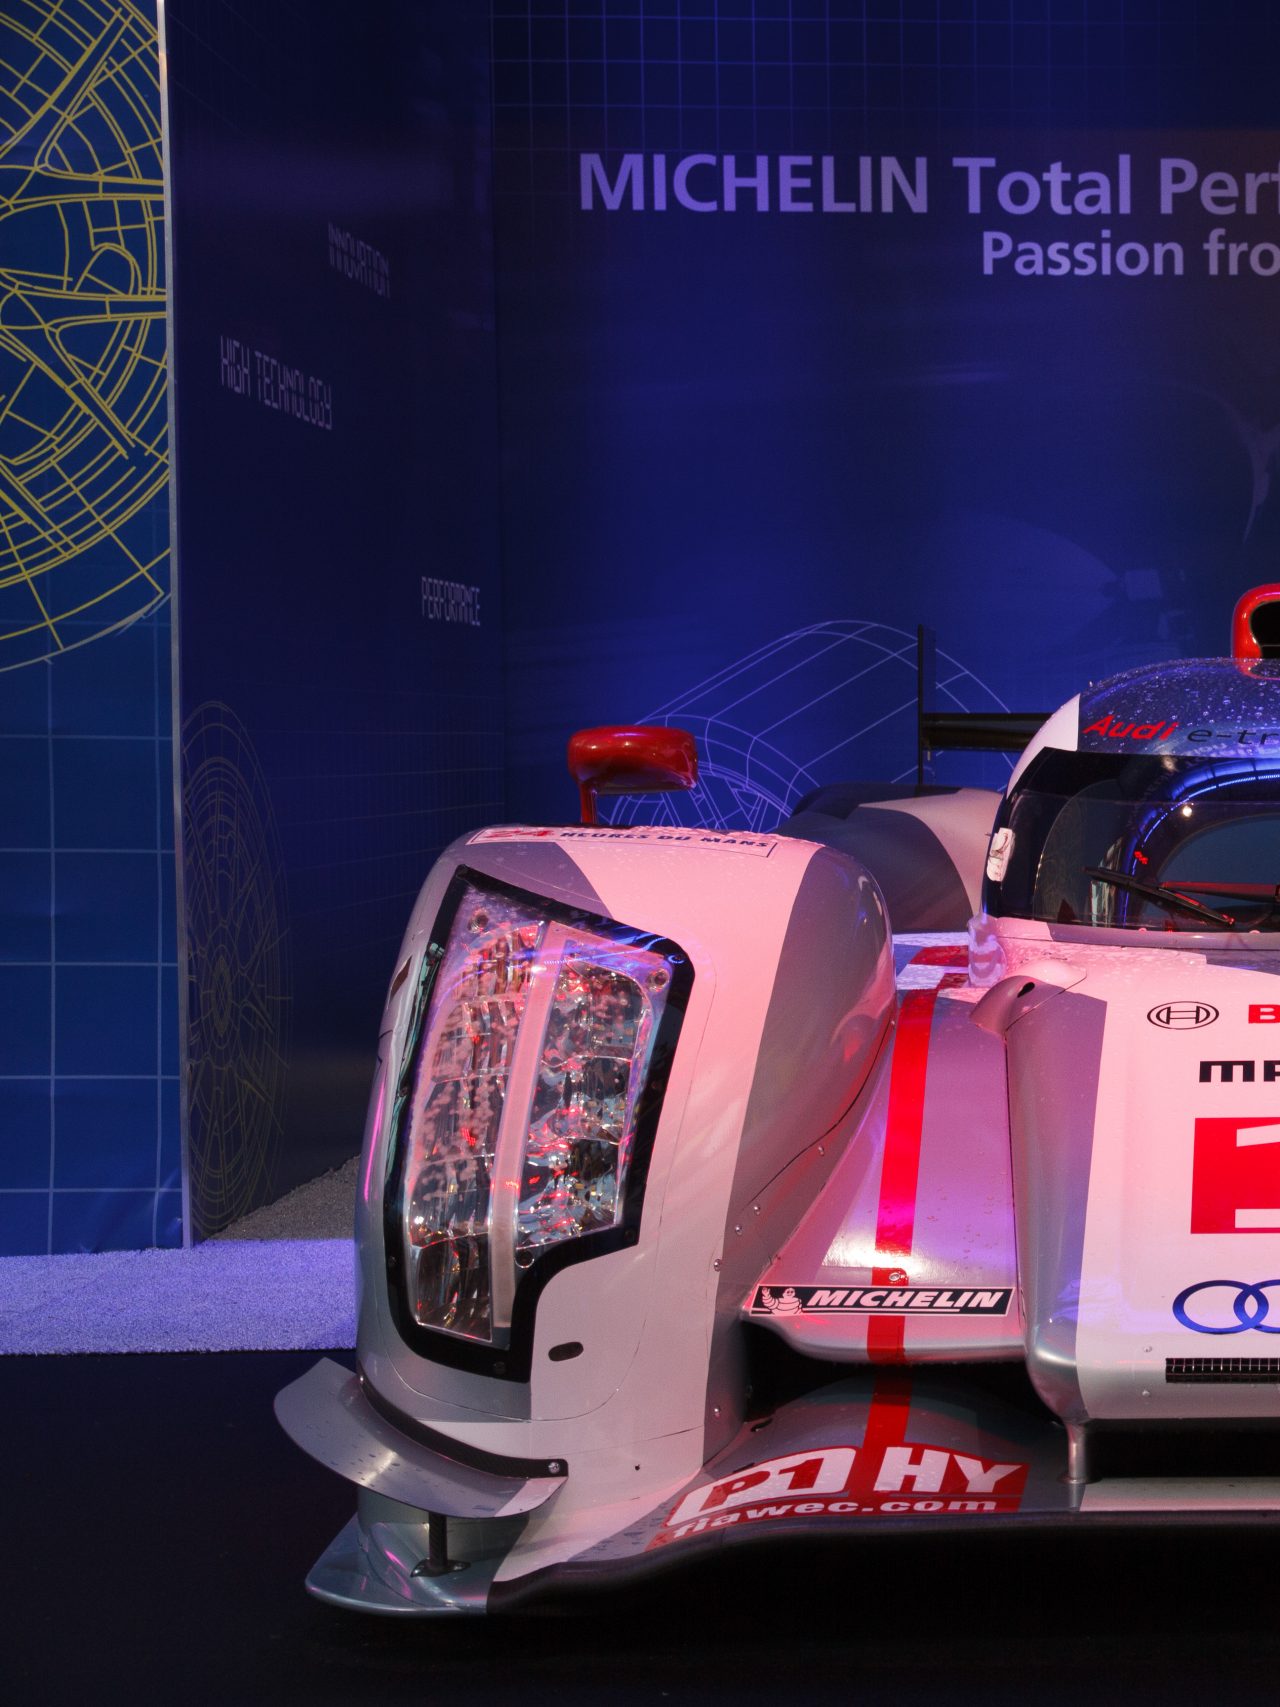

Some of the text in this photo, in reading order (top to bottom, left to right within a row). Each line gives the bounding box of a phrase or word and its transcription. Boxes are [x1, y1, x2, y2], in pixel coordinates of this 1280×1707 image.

[579, 153, 928, 213] MICHELIN
[952, 153, 1130, 215] Total
[328, 222, 390, 298] INNOVATION
[982, 229, 1184, 276] Passion
[220, 335, 333, 431] HIGH TECHNOLOGY
[421, 576, 480, 626] PERFORMANCE
[1082, 714, 1178, 741] Audi
[701, 836, 770, 847] MANS
[806, 1289, 1003, 1308] MICHELIN
[874, 1447, 1024, 1493] HY
[673, 1499, 997, 1538] fiawec.com
